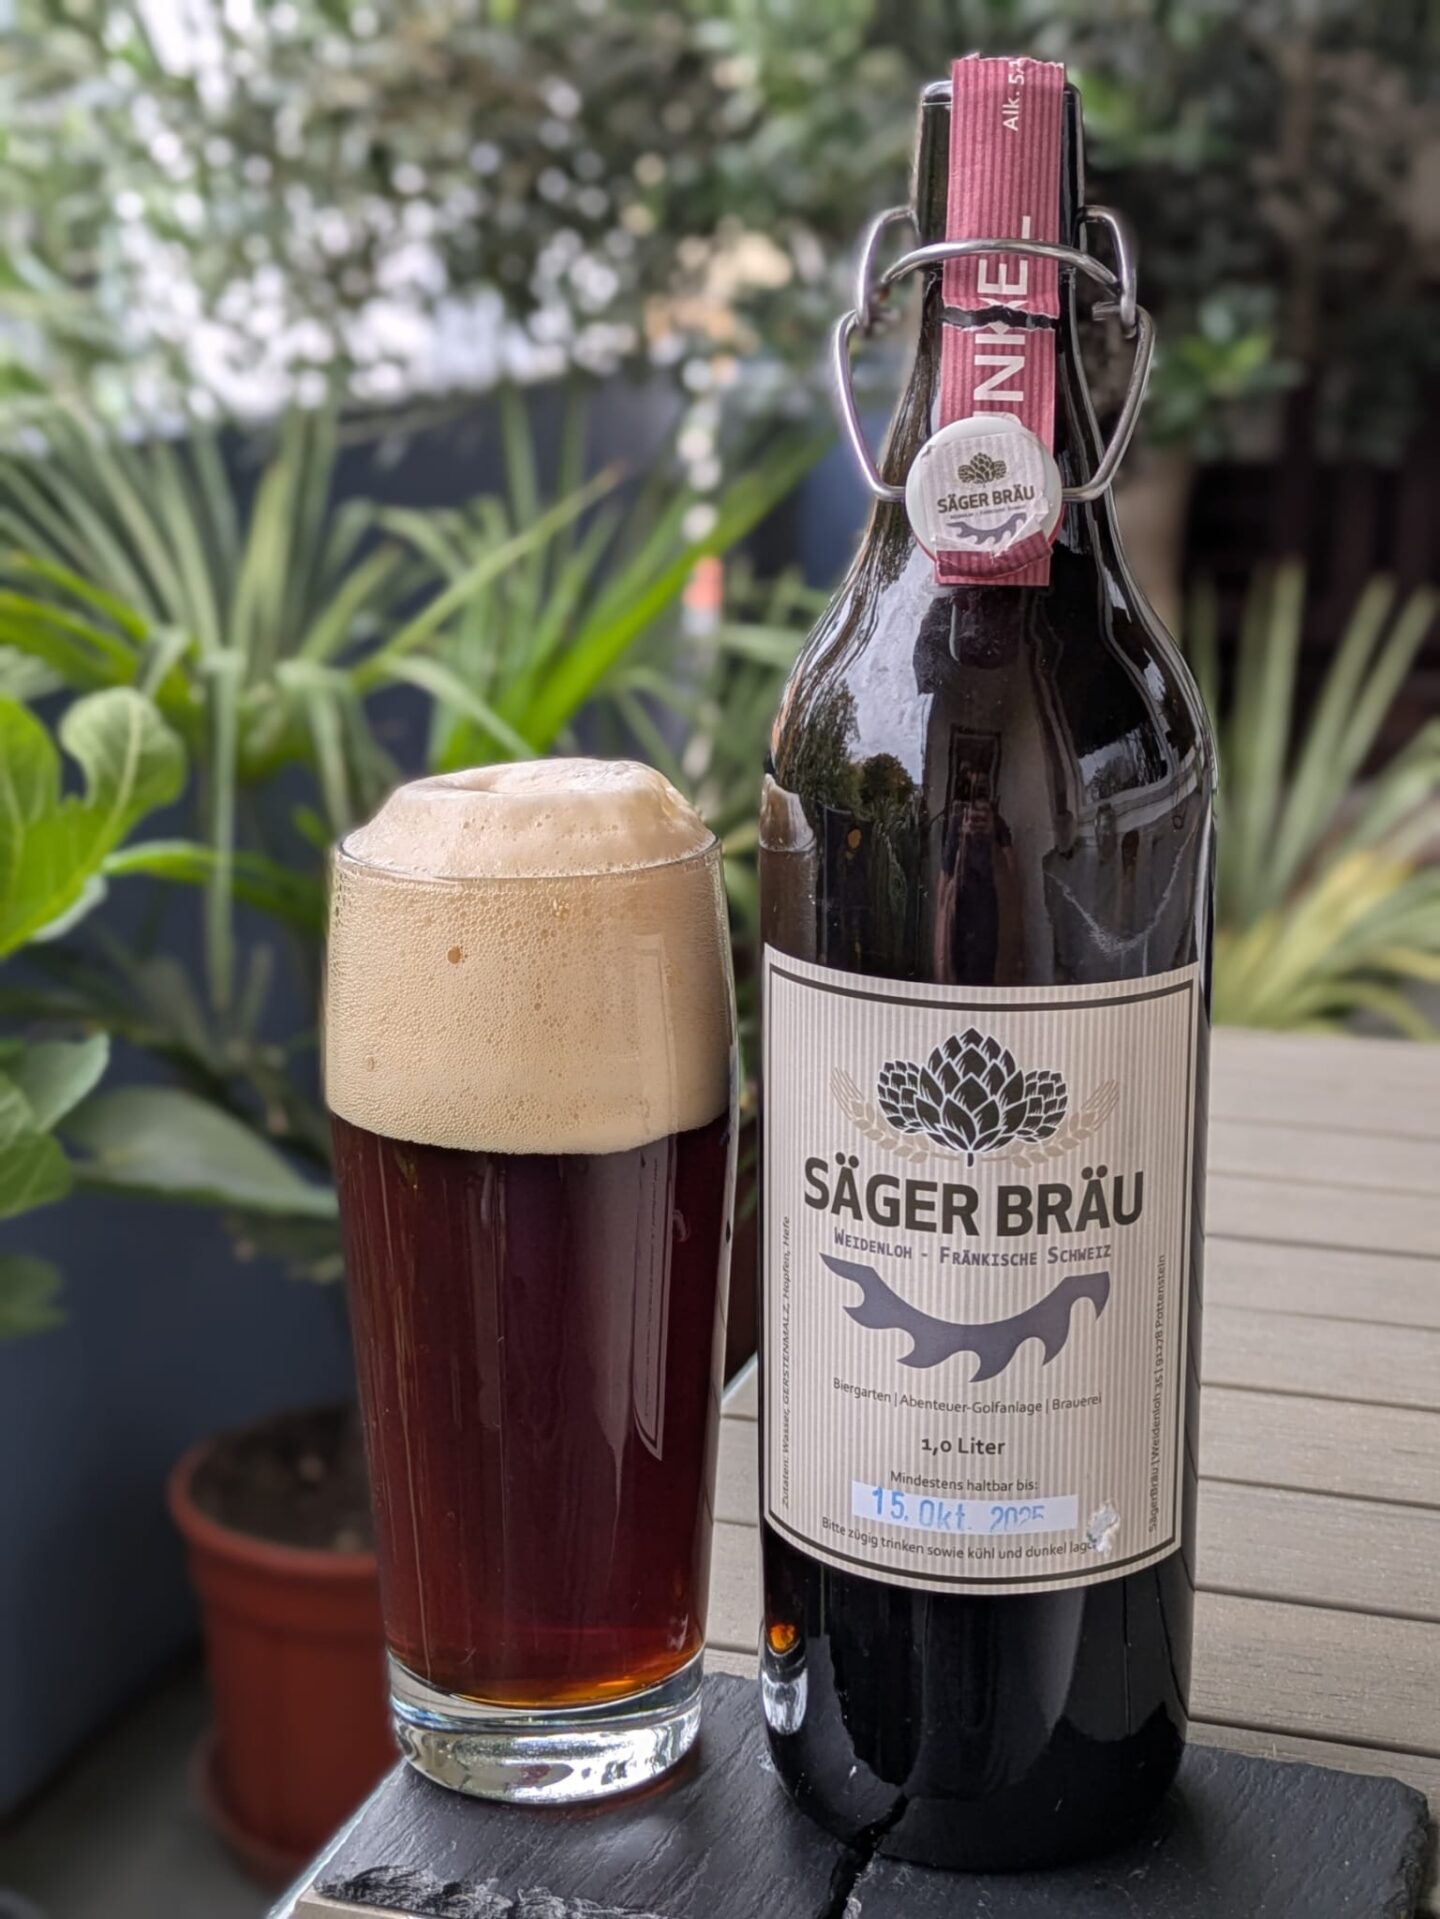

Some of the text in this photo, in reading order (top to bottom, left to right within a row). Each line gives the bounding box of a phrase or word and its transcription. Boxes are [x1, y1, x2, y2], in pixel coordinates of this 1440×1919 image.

[1001, 91, 1020, 132] Alk.
[937, 493, 990, 514] SÄGER
[992, 484, 1035, 505] BRÄU
[804, 1152, 1144, 1237] SÄGER BRÄU
[1155, 1254, 1166, 1329] Pottenstein
[781, 1216, 791, 1509] Zutaten: Wasser, GERSTENMALZ, Hopfen, Hefe
[1155, 1331, 1164, 1367] 91278
[833, 1377, 891, 1403] Biergarten
[900, 1394, 1042, 1415] Abenteuer-Golfanlage
[1052, 1391, 1102, 1410] Brauerei
[1154, 1375, 1163, 1391] 35
[1150, 1393, 1161, 1460] Weidenloh
[921, 1437, 1005, 1456] 1,0 Liter
[890, 1471, 1038, 1492] Mindestens haltbar bis:
[872, 1487, 909, 1521] 15.
[822, 1516, 846, 1537] Bitte
[848, 1527, 878, 1548] zügig
[881, 1536, 924, 1554] trinken
[927, 1546, 964, 1560] sowie
[967, 1545, 995, 1560] kühl
[998, 1545, 1022, 1560] und
[1025, 1542, 1067, 1558] dunkel
